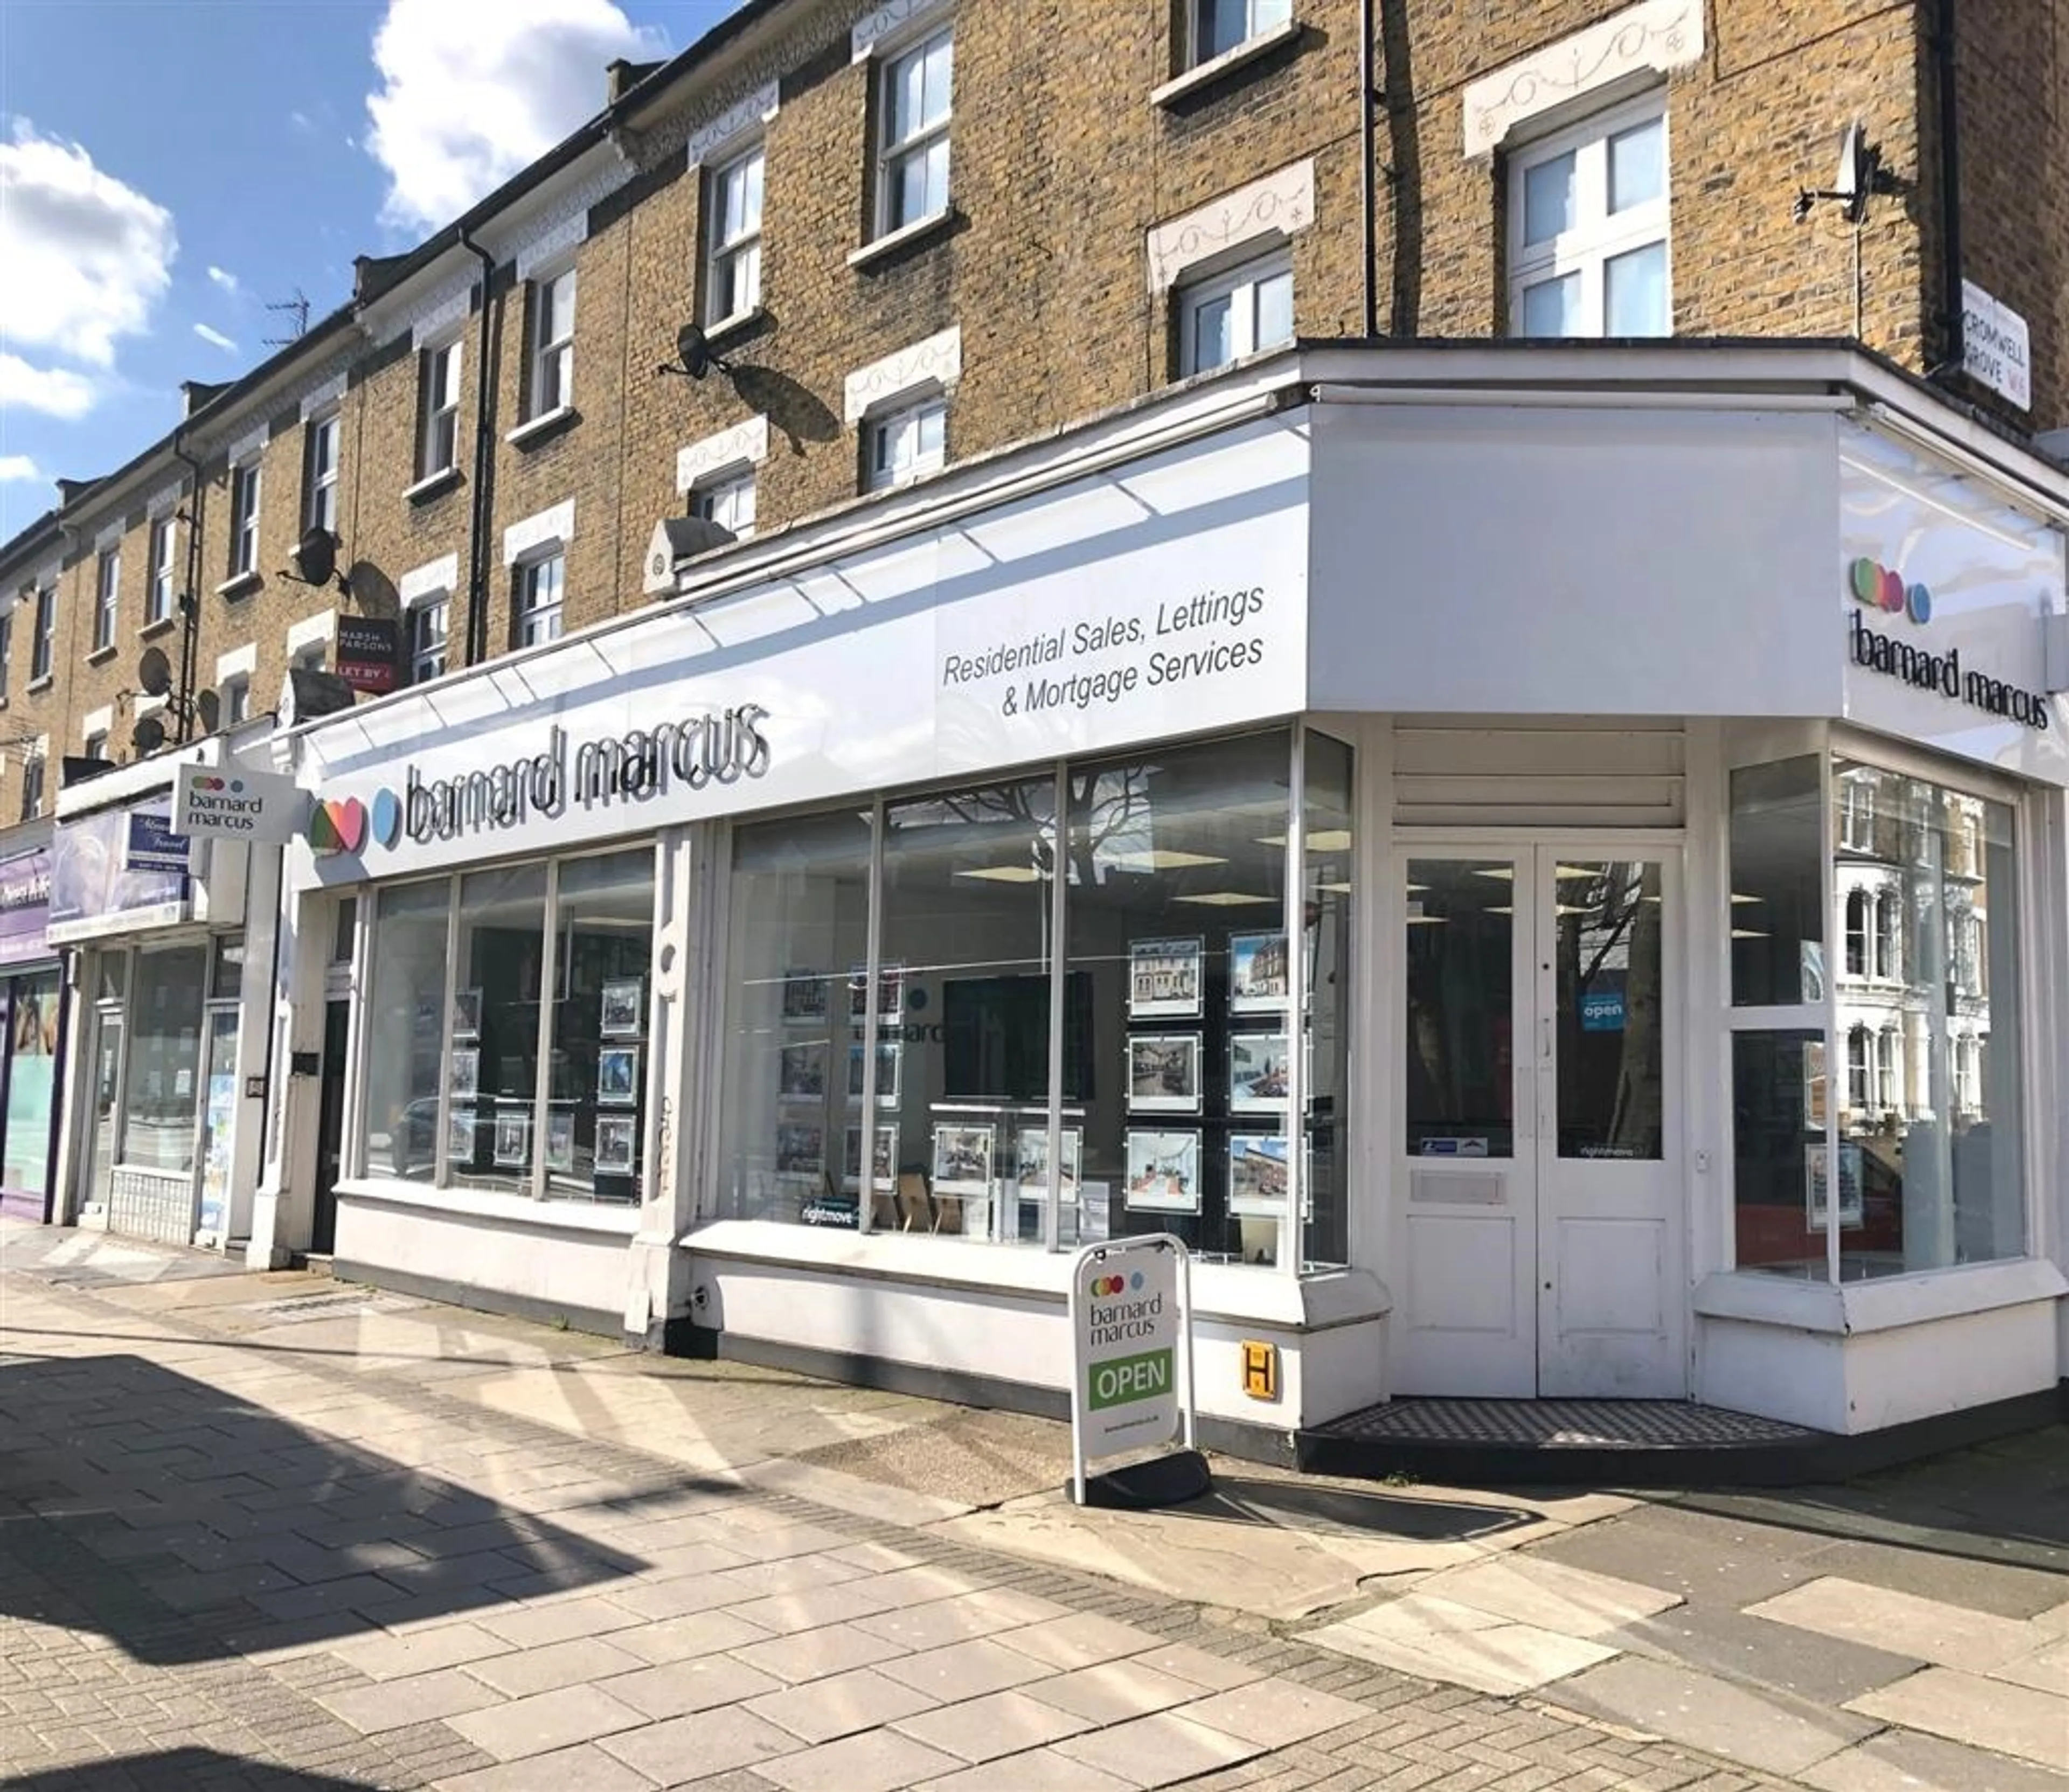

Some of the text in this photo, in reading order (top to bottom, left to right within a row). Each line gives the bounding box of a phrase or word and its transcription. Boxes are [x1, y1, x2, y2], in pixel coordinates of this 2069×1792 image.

[1964, 309, 2025, 368] CROMWELL
[943, 587, 1265, 685] Residential Sales, Lettings
[1002, 638, 1263, 716] & Mortgage Services
[1853, 608, 2049, 730] barnard marcus
[405, 703, 772, 844] barnard marcus
[189, 811, 254, 830] marcus
[190, 790, 262, 814] barnard
[1584, 1004, 1622, 1019] open
[802, 1205, 852, 1224] rightmove
[1091, 1293, 1162, 1327] barnard
[1091, 1318, 1155, 1347] marcus
[1097, 1358, 1166, 1399] OPEN
[1246, 1347, 1269, 1392] H
